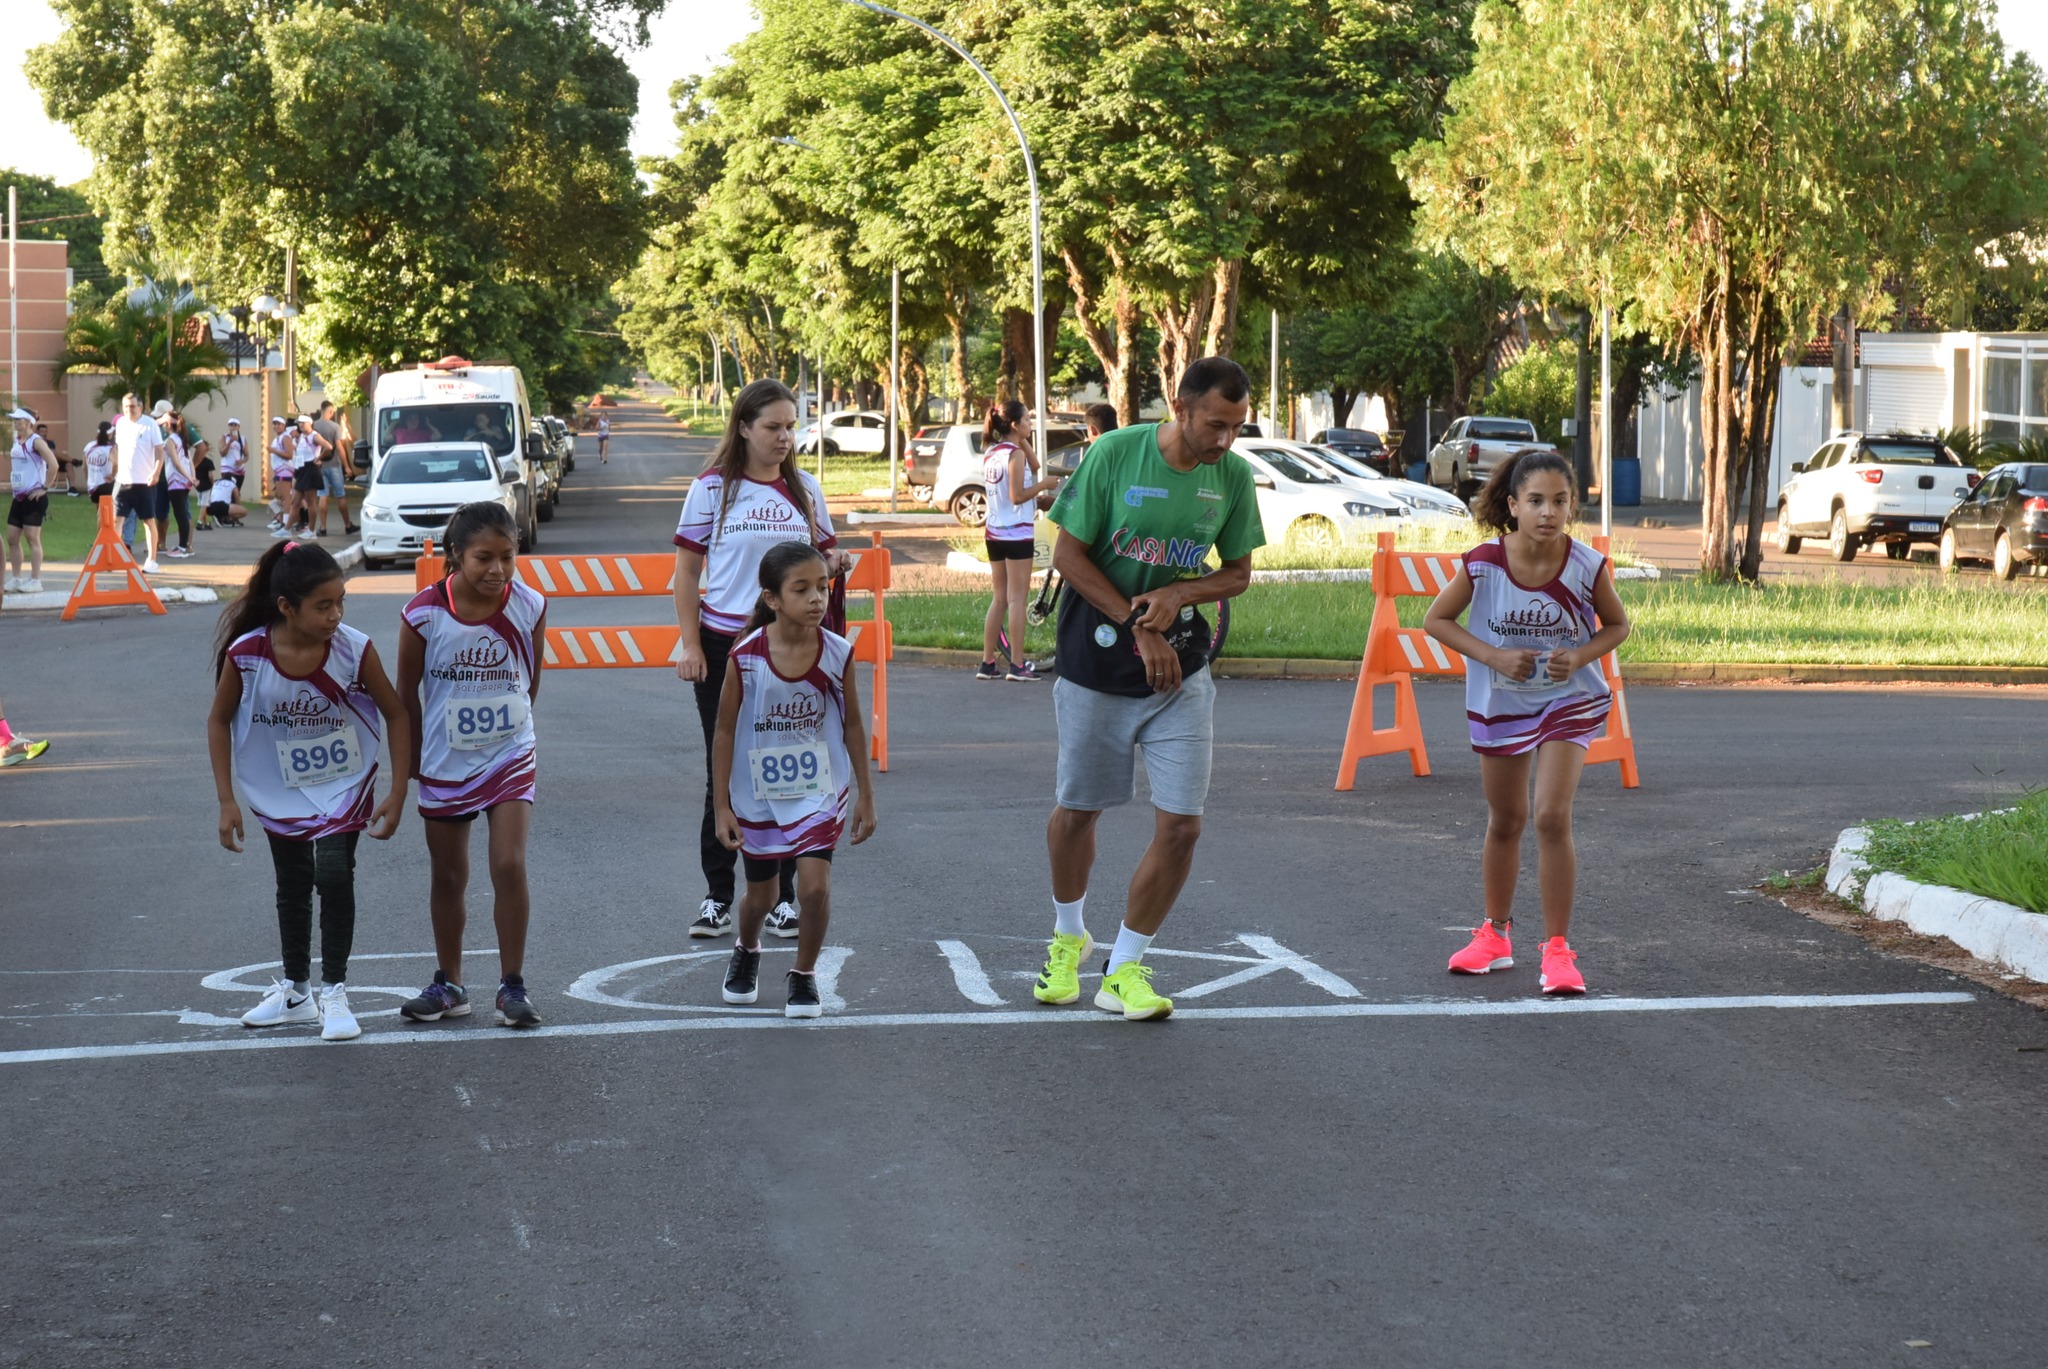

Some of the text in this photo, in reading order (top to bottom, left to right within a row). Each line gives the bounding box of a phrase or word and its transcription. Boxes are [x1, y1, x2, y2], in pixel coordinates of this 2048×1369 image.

[457, 704, 515, 735] 891
[290, 738, 349, 773] 896
[761, 750, 819, 784] 899
